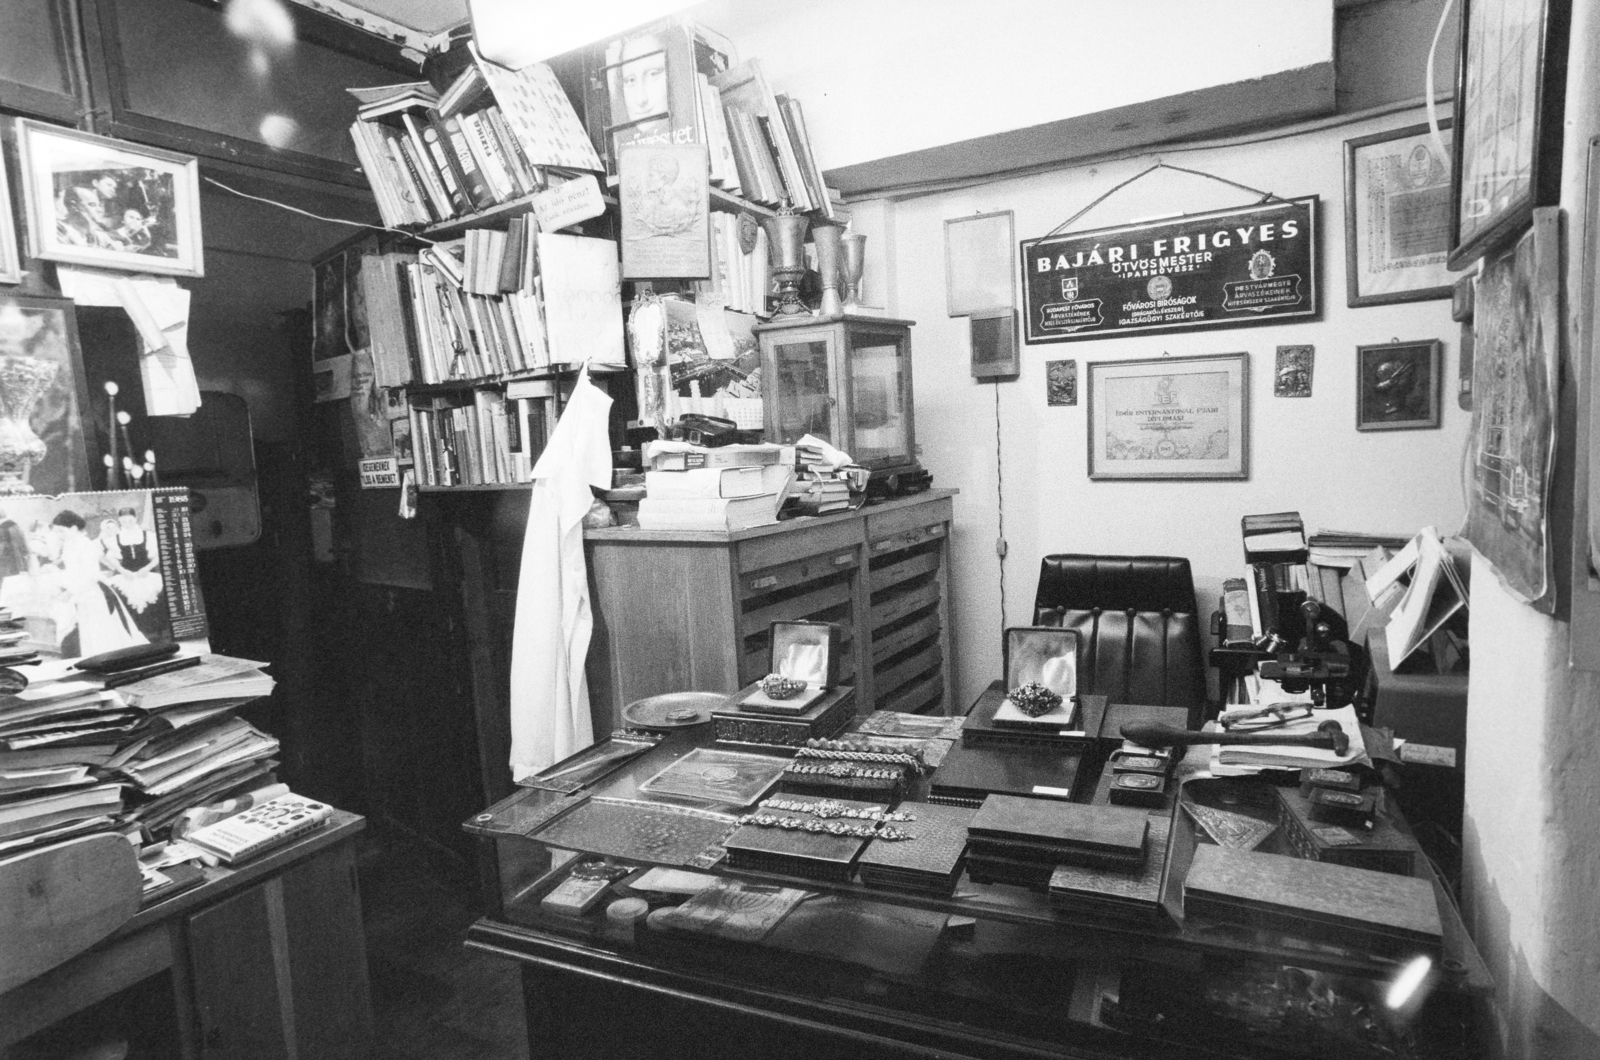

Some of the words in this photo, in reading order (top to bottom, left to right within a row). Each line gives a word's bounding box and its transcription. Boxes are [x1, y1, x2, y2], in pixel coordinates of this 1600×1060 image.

[473, 119, 492, 157] FIZIKA
[1037, 243, 1138, 273] BAJÁRI
[1154, 219, 1299, 257] FRIGYES
[1122, 300, 1156, 311] FŐVÁROSI
[1118, 315, 1163, 325] IGAZSÁGÜGYI
[1165, 310, 1205, 321] SZAKÉRTŐJE
[168, 495, 189, 503] 1985
